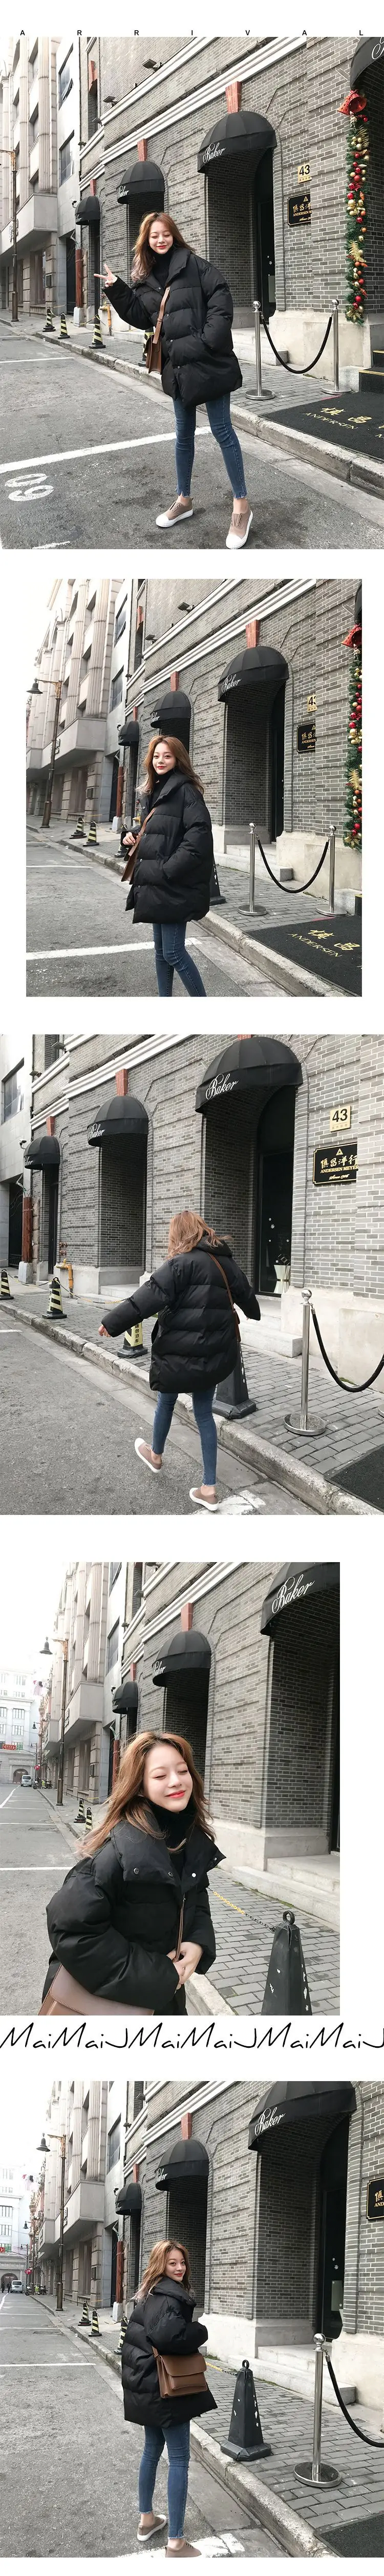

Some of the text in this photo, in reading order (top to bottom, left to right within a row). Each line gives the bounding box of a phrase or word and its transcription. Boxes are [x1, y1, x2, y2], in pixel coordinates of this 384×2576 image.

[299, 164, 310, 176] 43
[302, 412, 360, 429] ANDERSEN
[287, 933, 343, 957] ANDERSEN
[206, 1073, 239, 1100] Baker
[332, 1108, 348, 1122] 43
[272, 1574, 315, 1614] Baker
